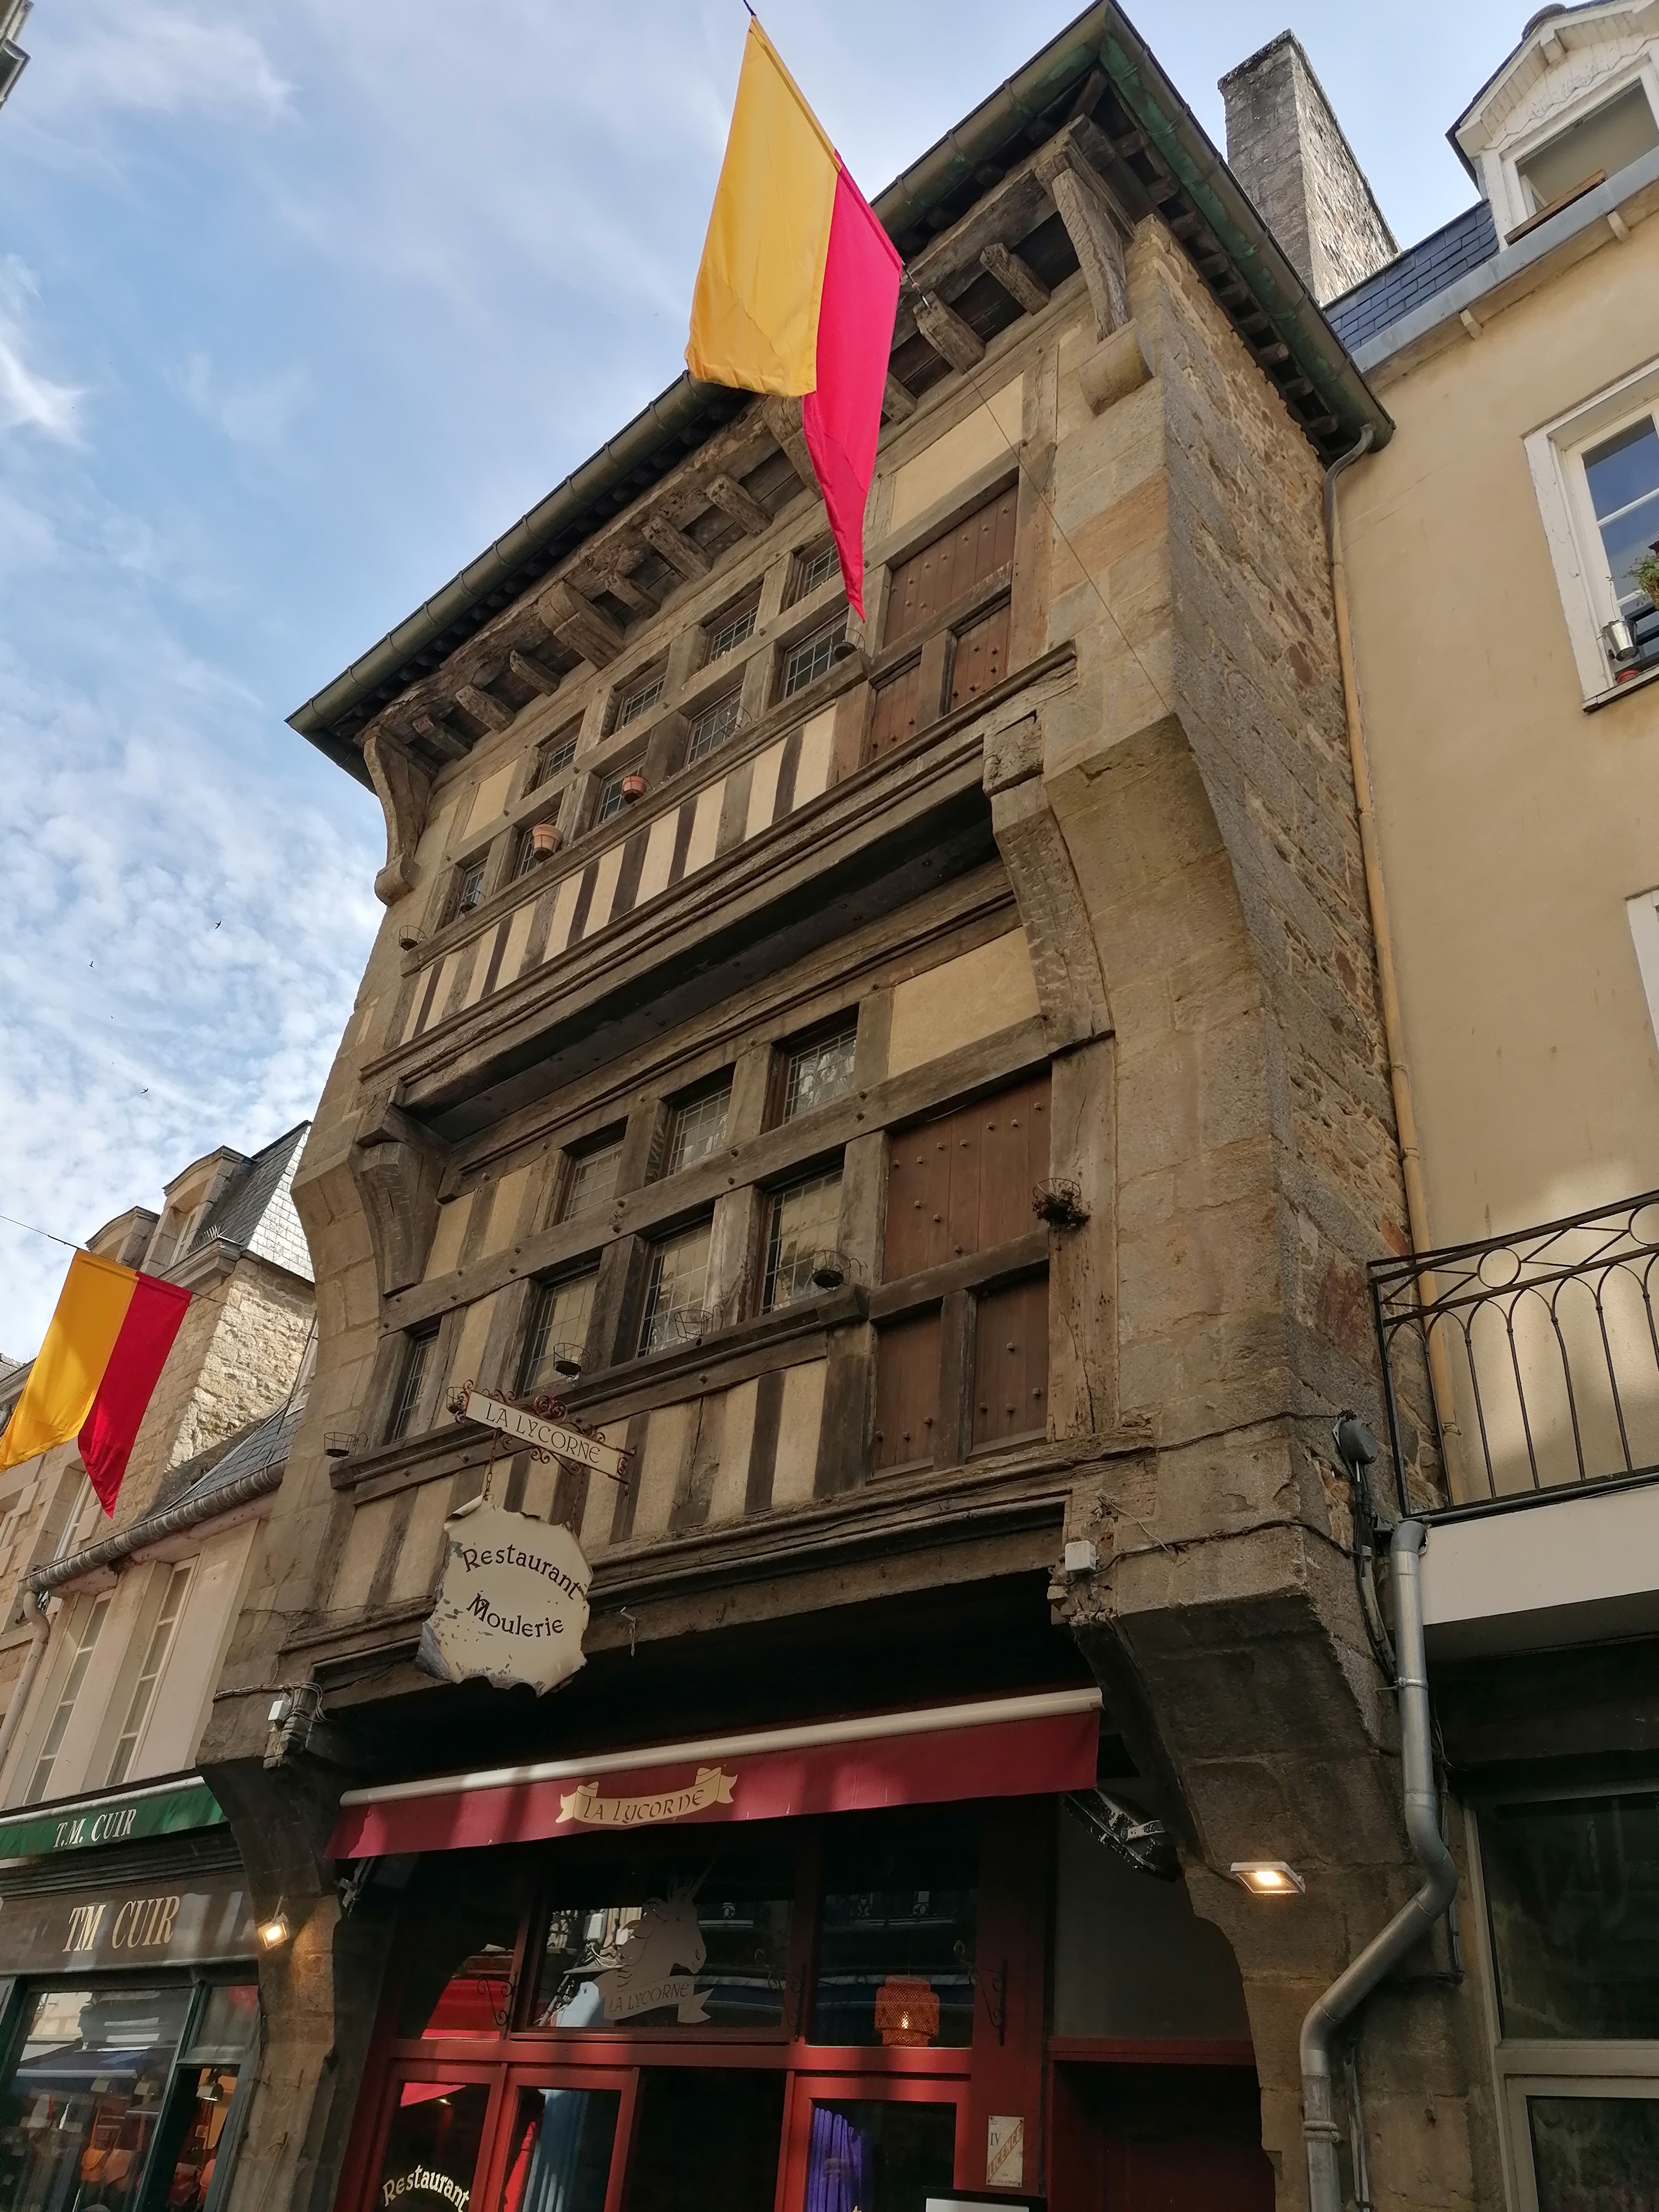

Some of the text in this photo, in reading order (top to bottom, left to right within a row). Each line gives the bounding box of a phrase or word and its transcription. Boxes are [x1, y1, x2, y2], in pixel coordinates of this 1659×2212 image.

[484, 1402, 601, 1463] LA LYCORNE
[462, 1544, 580, 1600] Restaurant
[466, 1593, 564, 1638] Moulerie
[53, 1809, 137, 1848] T.M. CUIR
[583, 1789, 704, 1824] LA LYCORNE
[62, 1896, 180, 1952] TM CUIR
[609, 1983, 690, 2012] LA LYCORNE
[988, 2123, 1021, 2179] LICENCE
[989, 2132, 1001, 2146] IV
[382, 2164, 469, 2212] Restaurant
